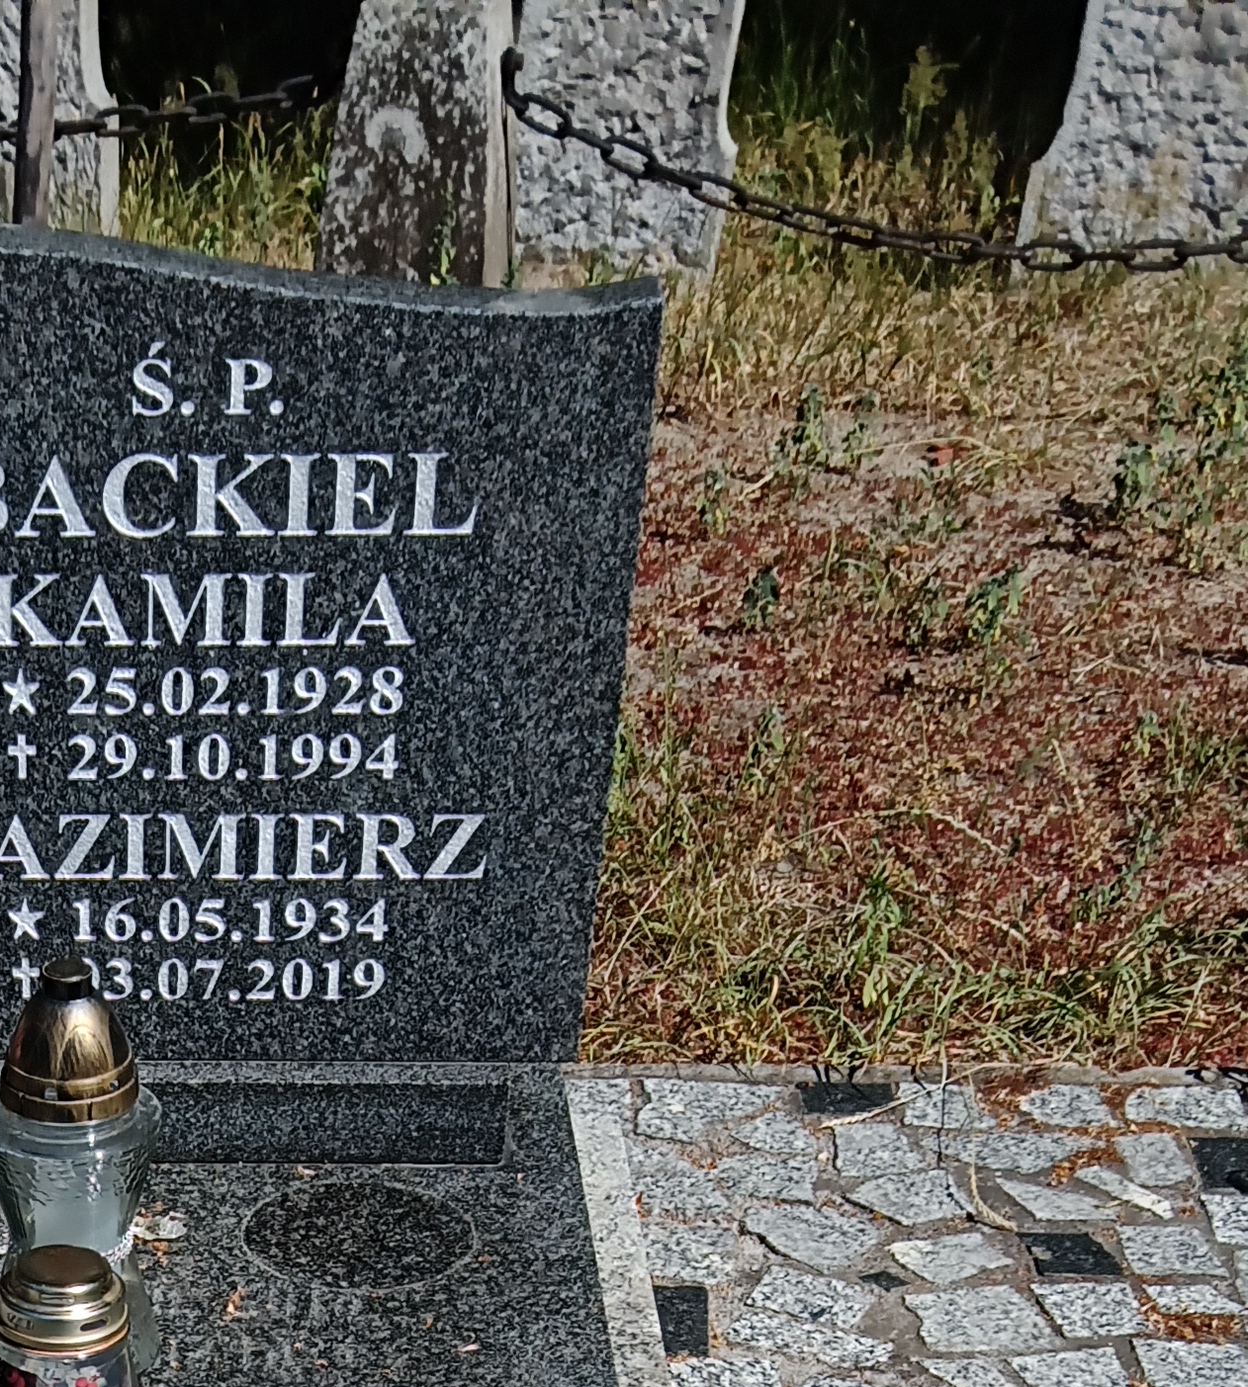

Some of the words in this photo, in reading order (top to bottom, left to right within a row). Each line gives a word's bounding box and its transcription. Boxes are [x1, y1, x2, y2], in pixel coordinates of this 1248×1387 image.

[131, 341, 195, 417] Ś.
[224, 358, 284, 417] P.
[65, 666, 405, 717] 25.02.1928
[66, 732, 400, 782] 29.10.1994
[72, 896, 389, 944] 16.05.1934
[82, 957, 387, 1003] 3.07.2019
